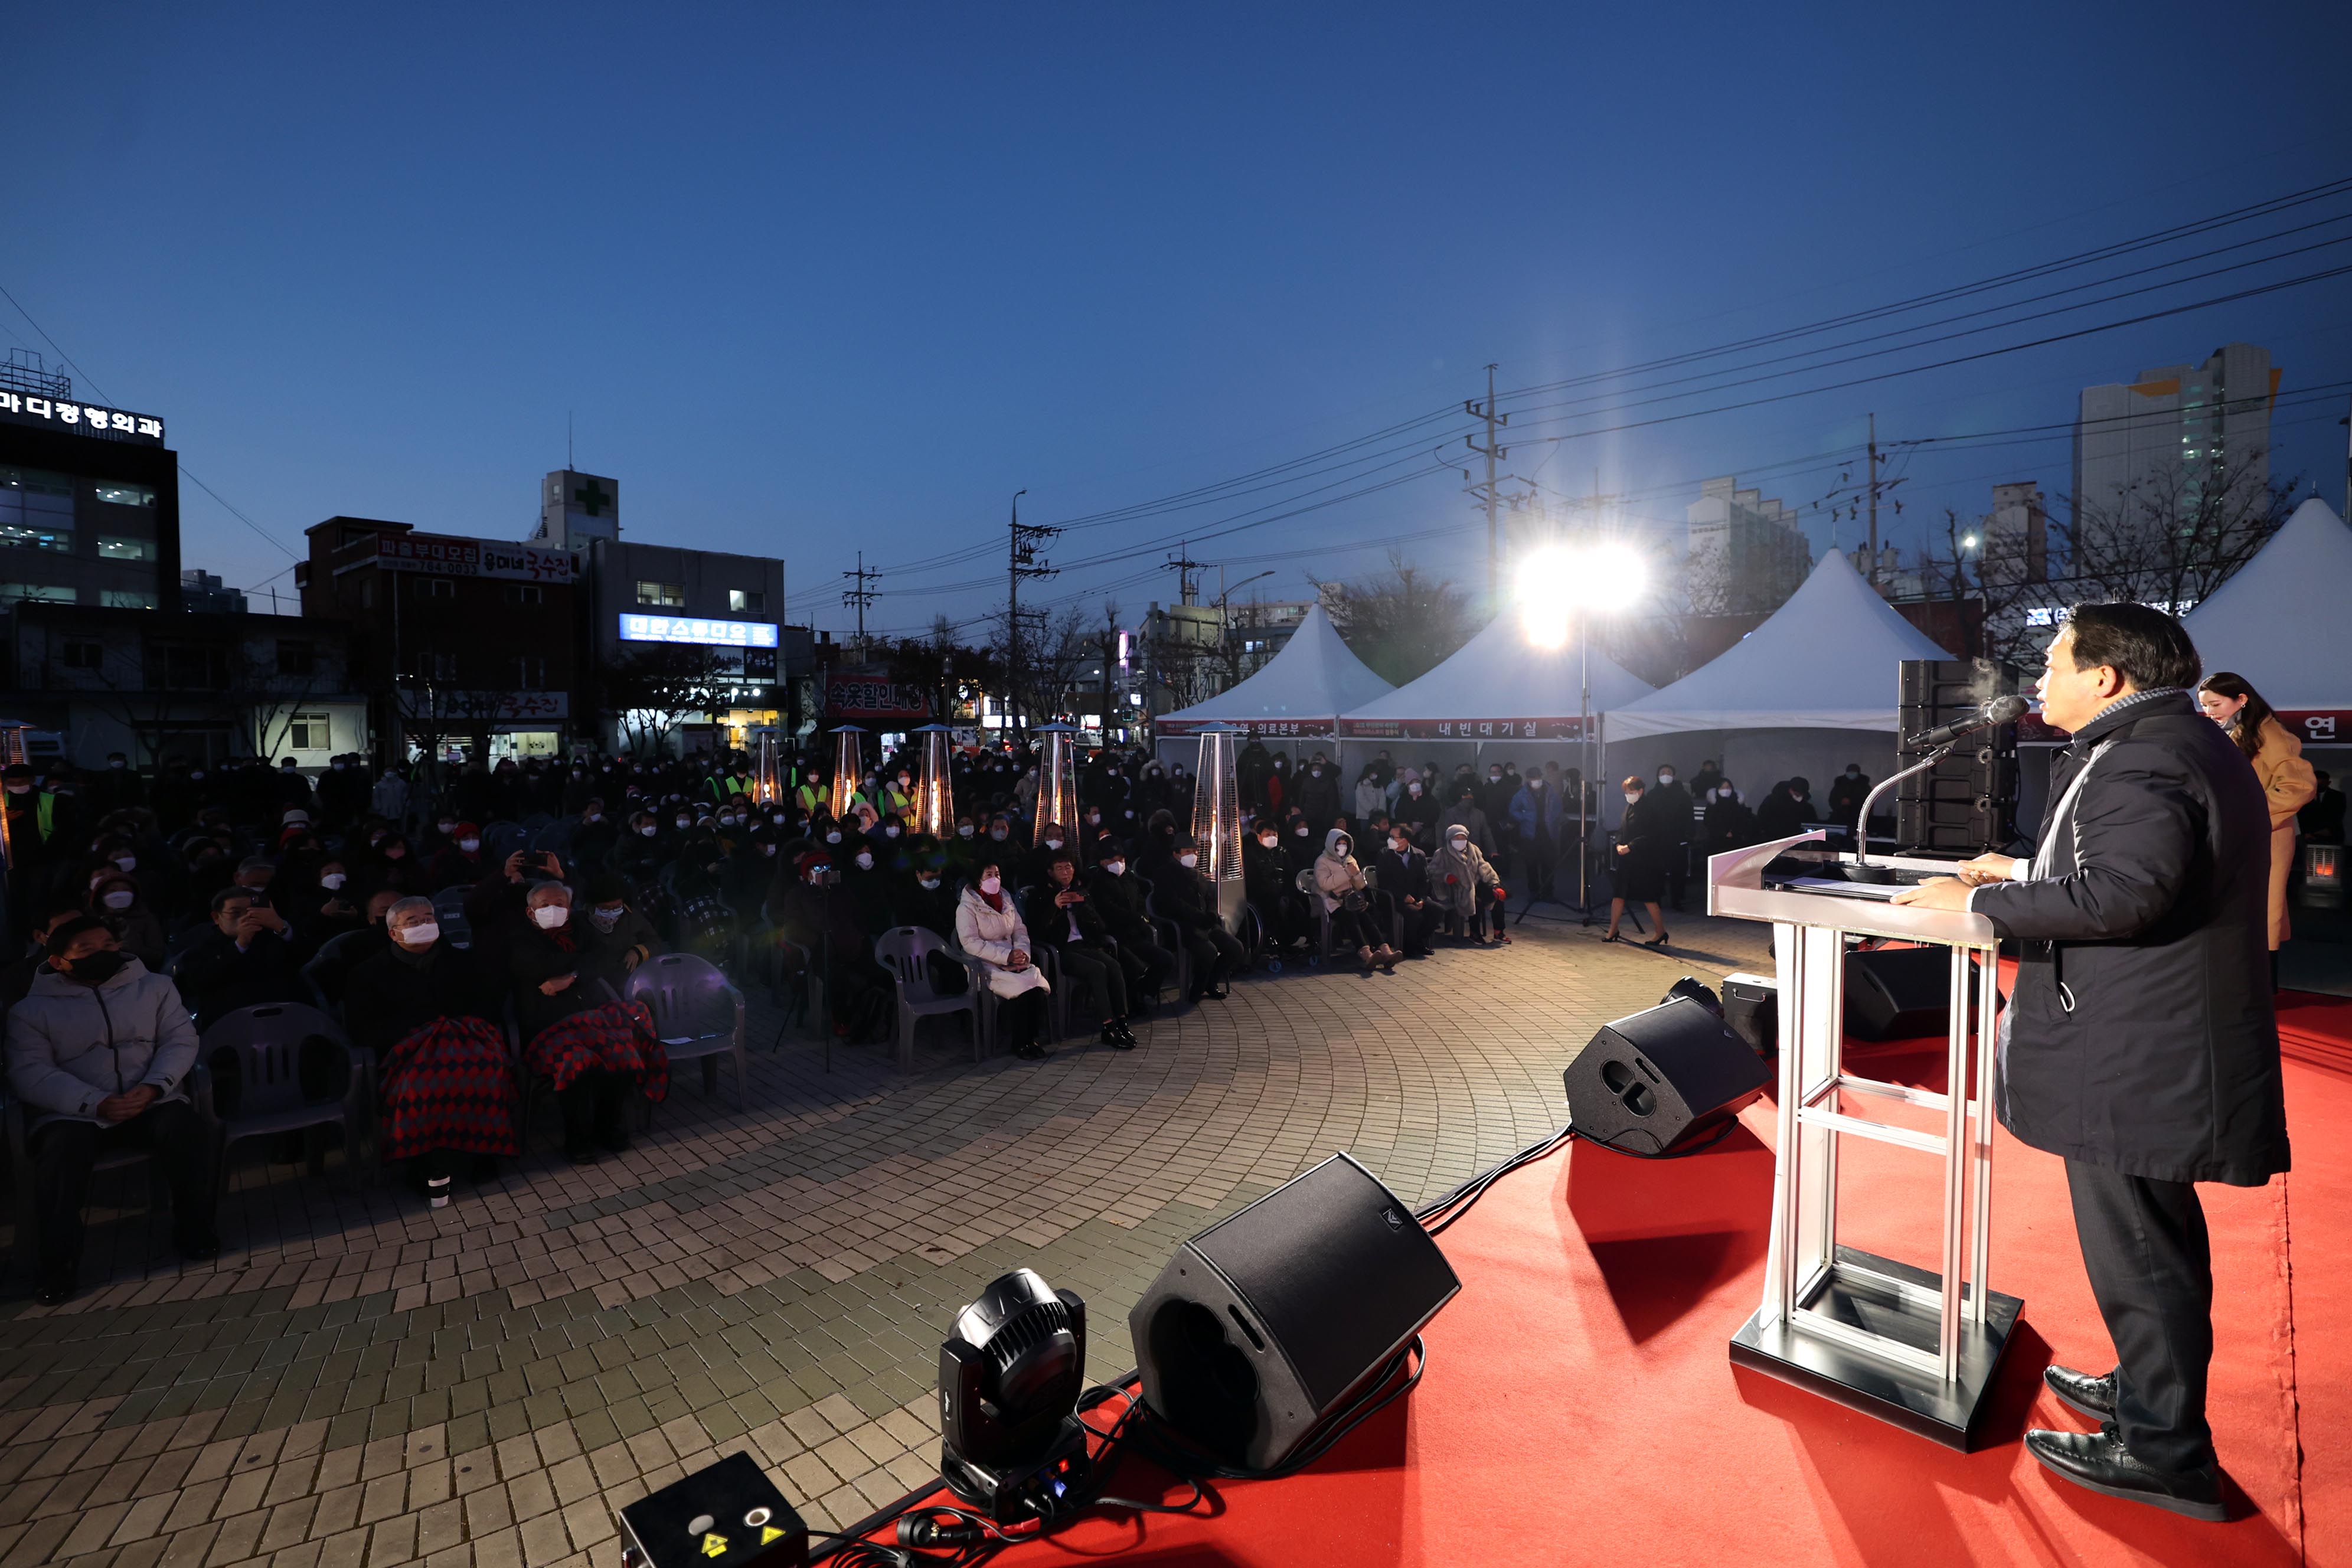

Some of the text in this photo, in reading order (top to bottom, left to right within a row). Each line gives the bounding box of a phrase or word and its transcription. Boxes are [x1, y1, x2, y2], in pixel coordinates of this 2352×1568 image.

[0, 392, 163, 438] 마디정형외과
[527, 551, 569, 579] 국수집
[502, 695, 558, 718] 국수집
[2305, 716, 2336, 740] 연
